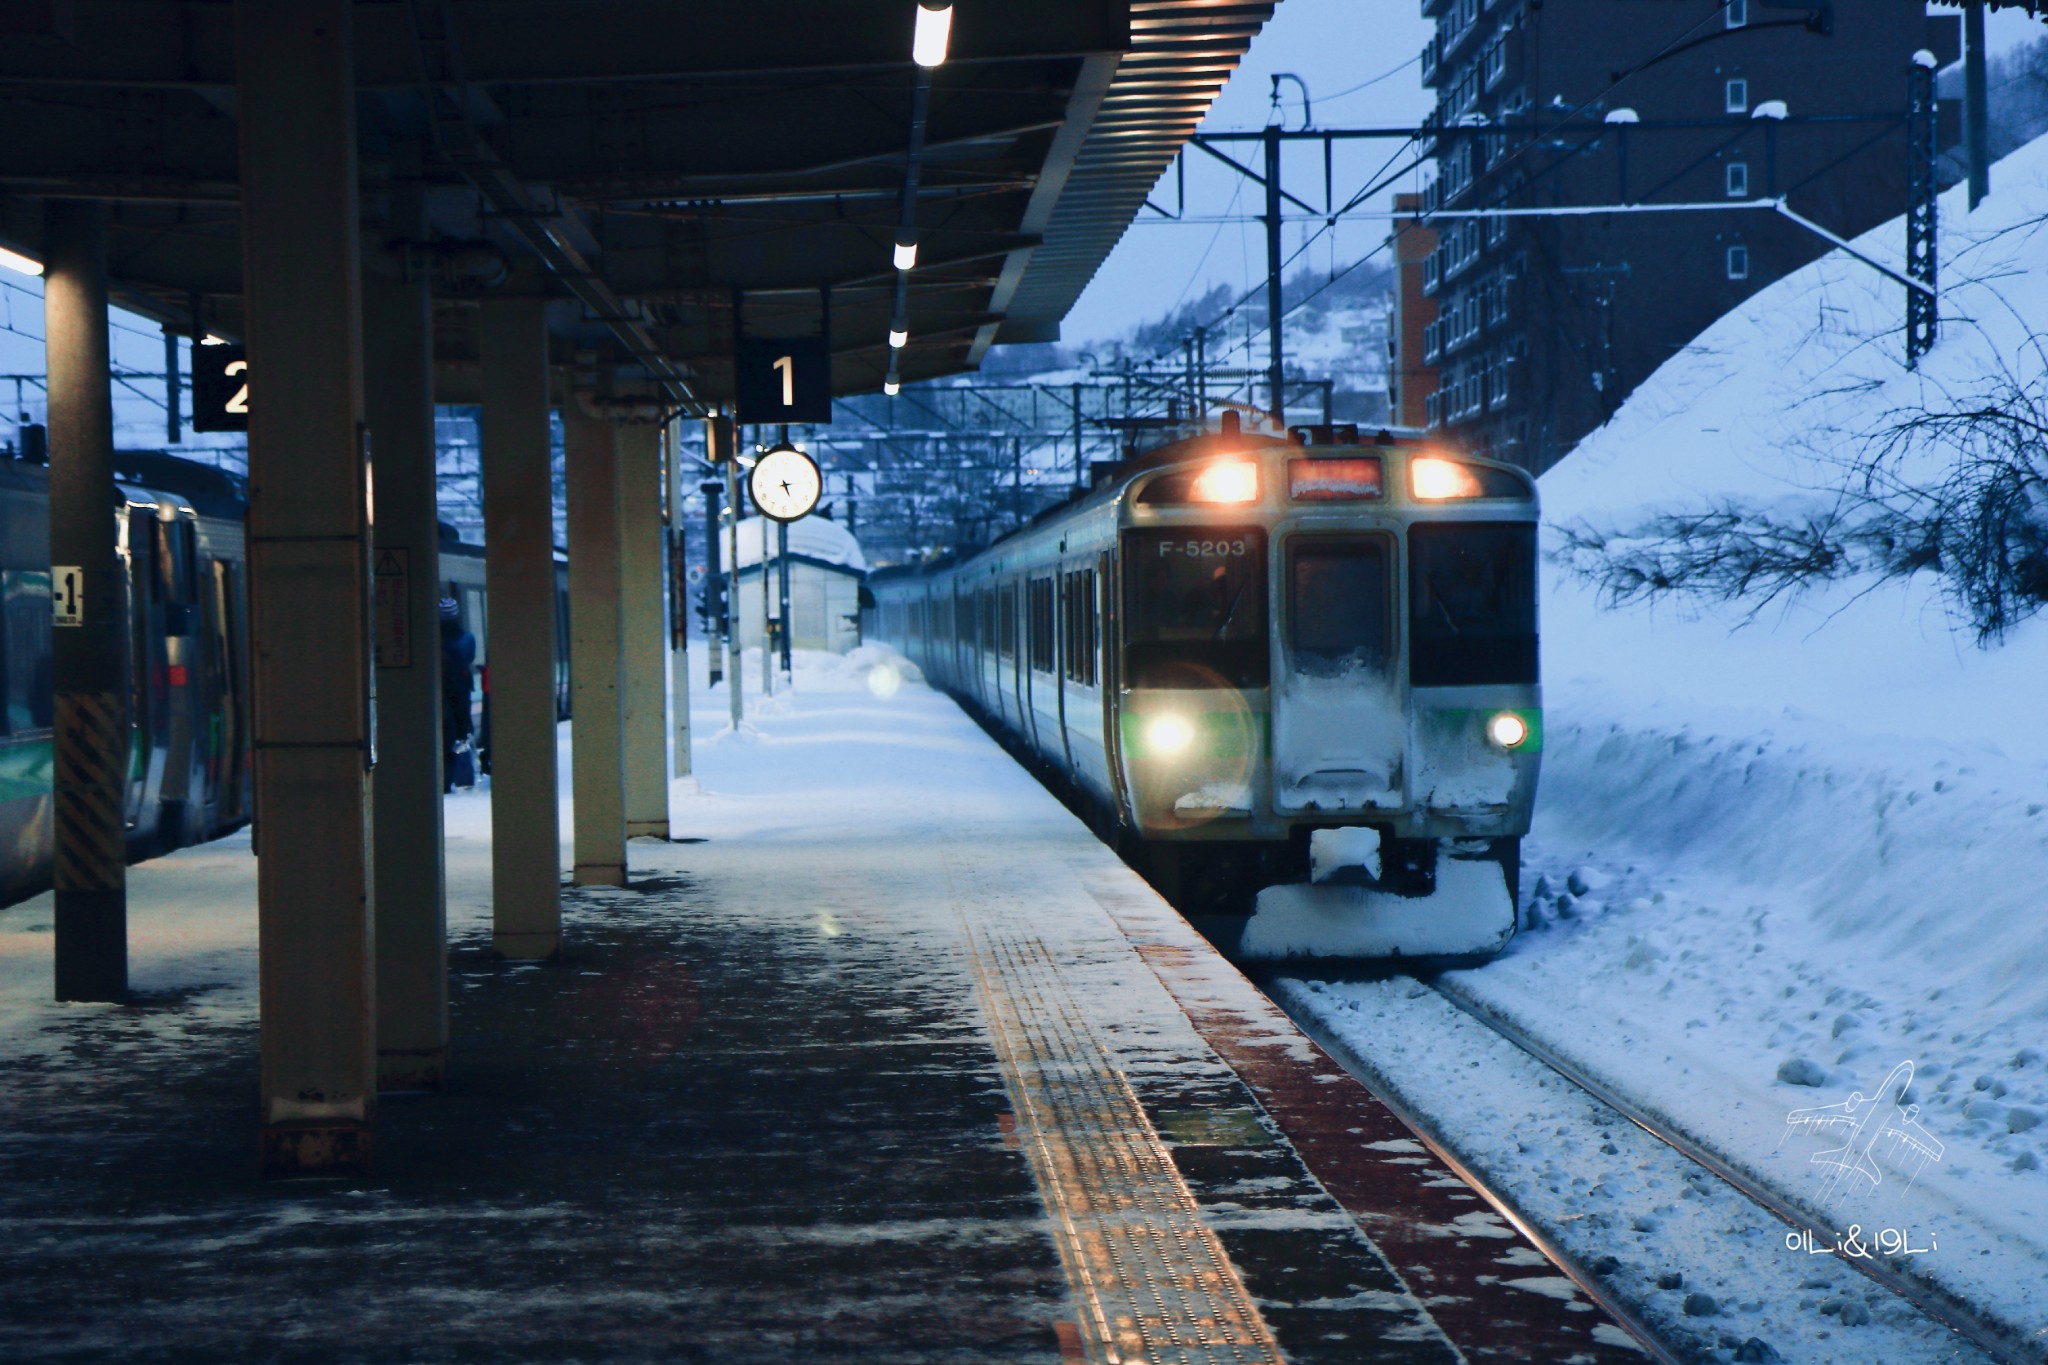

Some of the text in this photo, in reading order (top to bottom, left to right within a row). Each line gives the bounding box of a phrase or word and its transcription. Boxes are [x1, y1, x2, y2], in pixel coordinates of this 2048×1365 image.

[224, 361, 248, 413] 2
[773, 356, 793, 406] 1
[1159, 540, 1245, 558] F-5203
